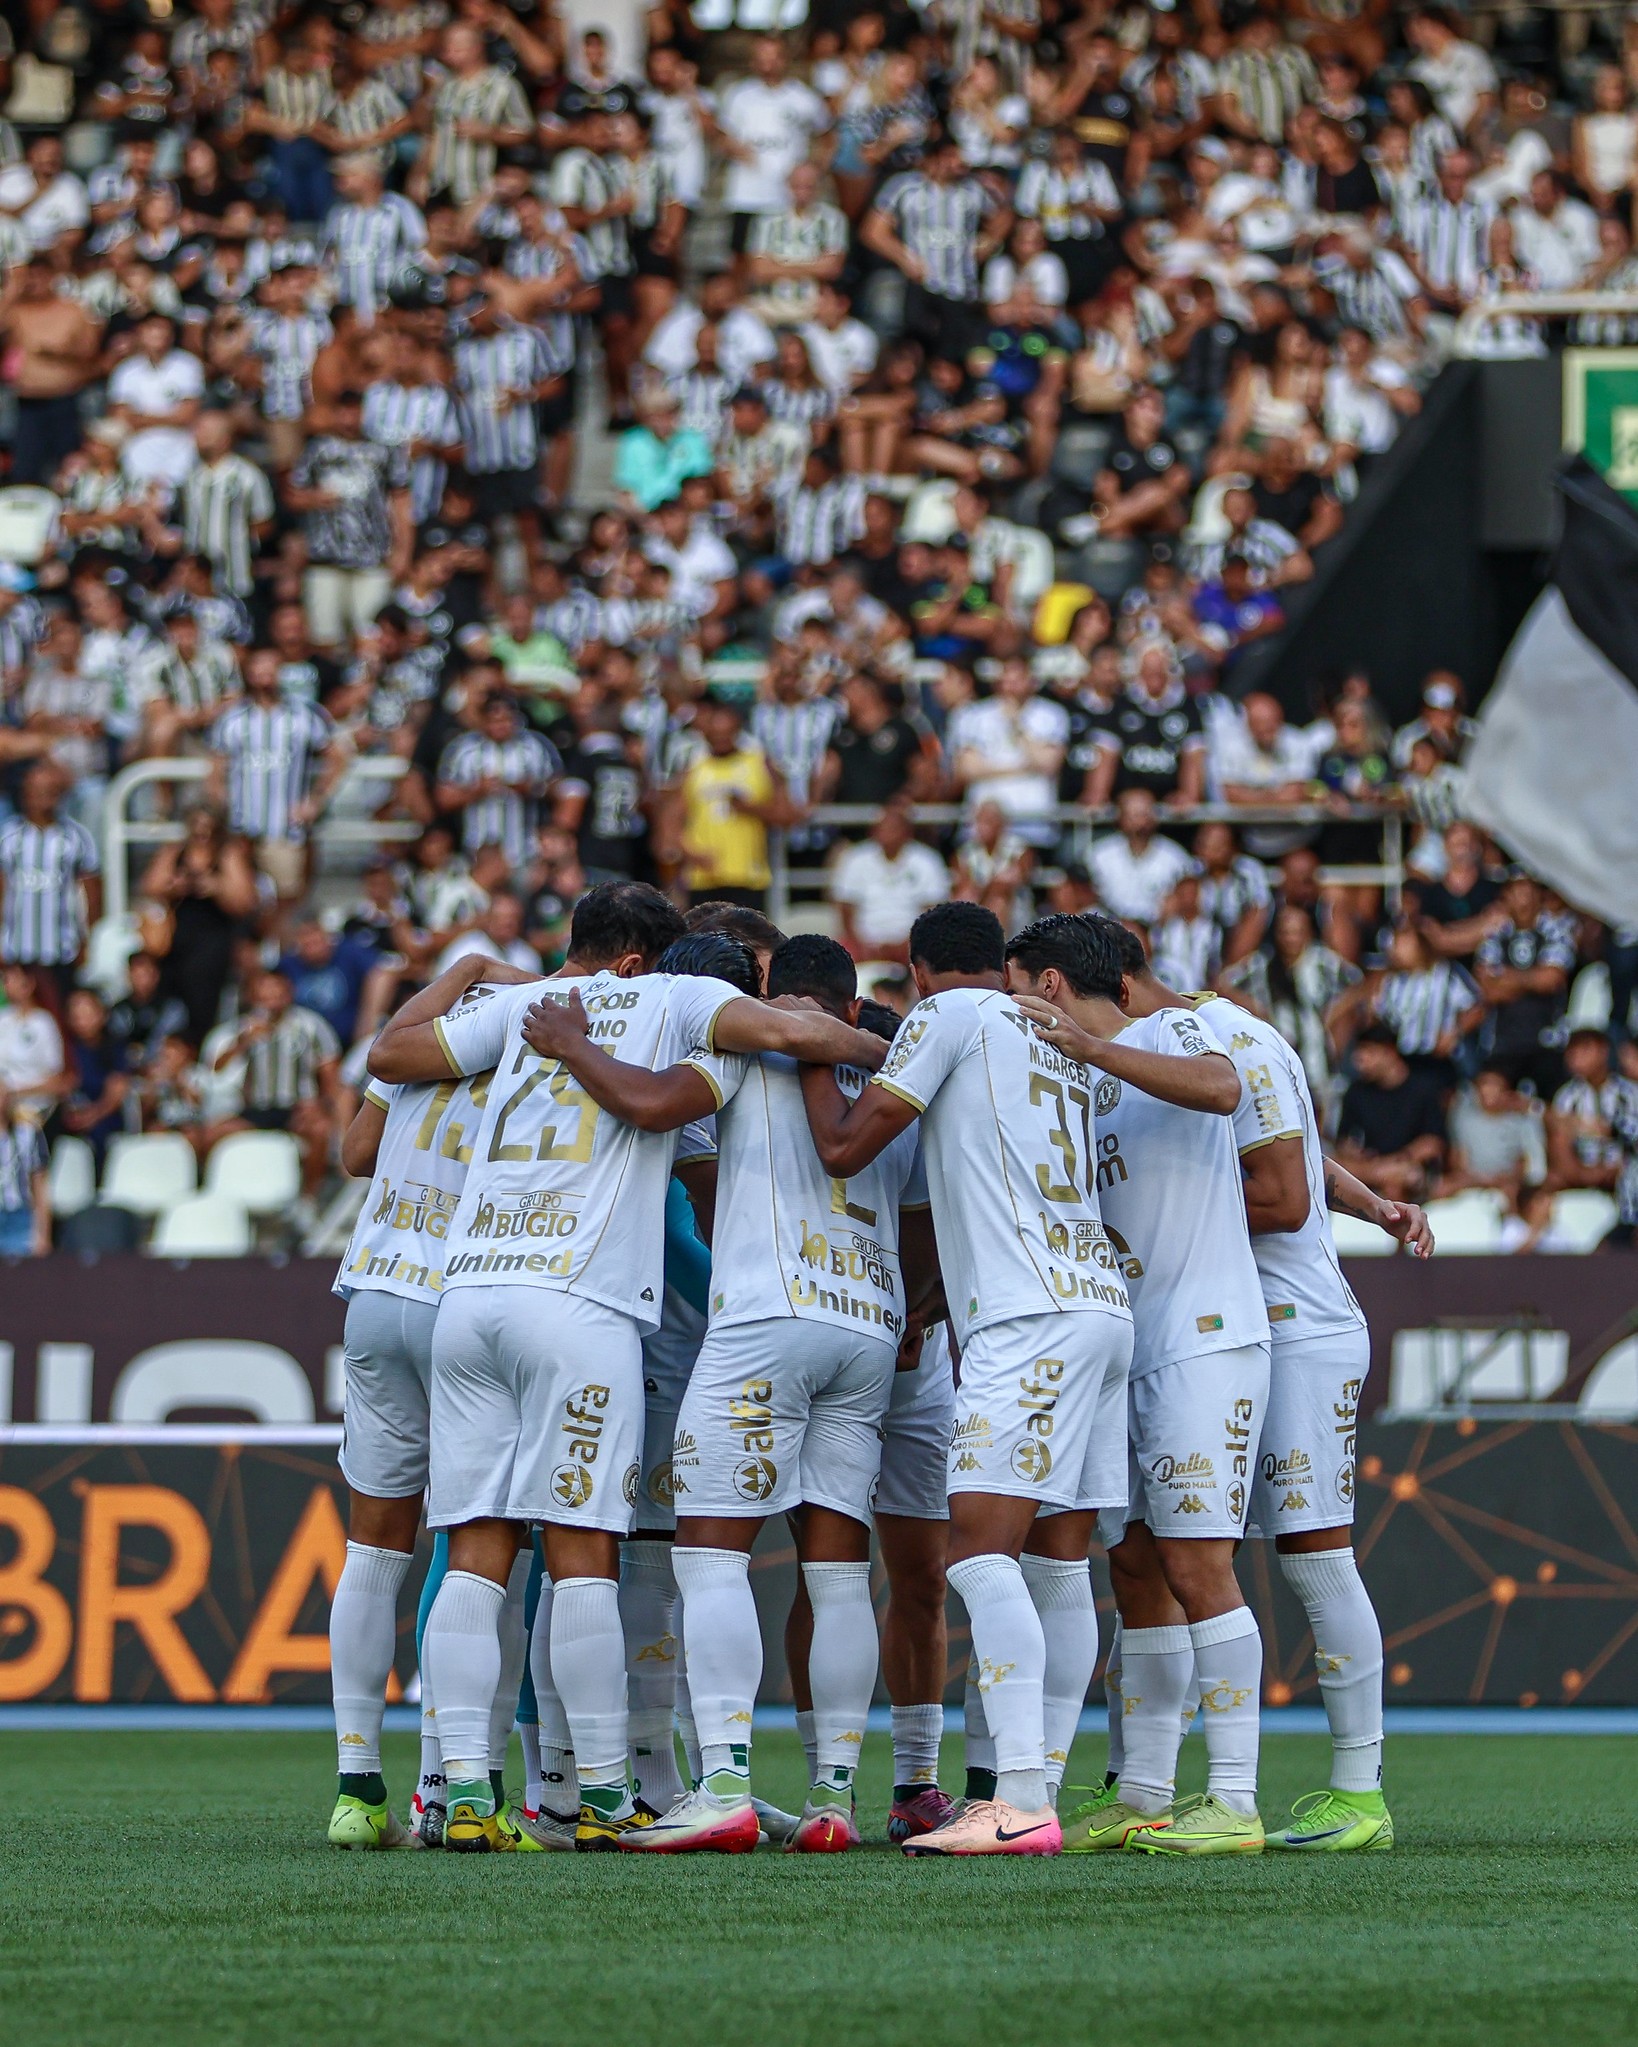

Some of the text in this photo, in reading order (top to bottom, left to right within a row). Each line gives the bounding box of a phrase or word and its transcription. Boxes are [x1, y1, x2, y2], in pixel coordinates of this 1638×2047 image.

[1029, 1071, 1095, 1203] 37
[519, 1194, 562, 1209] GRUPO
[392, 1202, 449, 1241] BUG
[492, 1211, 578, 1239] BUGIO
[1075, 1223, 1106, 1238] GRU
[446, 1248, 574, 1277] Unimed
[1048, 1266, 1132, 1312] Unim
[1018, 1358, 1065, 1437] alfa
[562, 1384, 611, 1464] alfa
[729, 1379, 775, 1454] alfa
[1225, 1398, 1253, 1478] alfa
[1151, 1452, 1214, 1483] Dalla
[1261, 1448, 1311, 1481] Dalla
[1168, 1480, 1217, 1490] PURO MALTE
